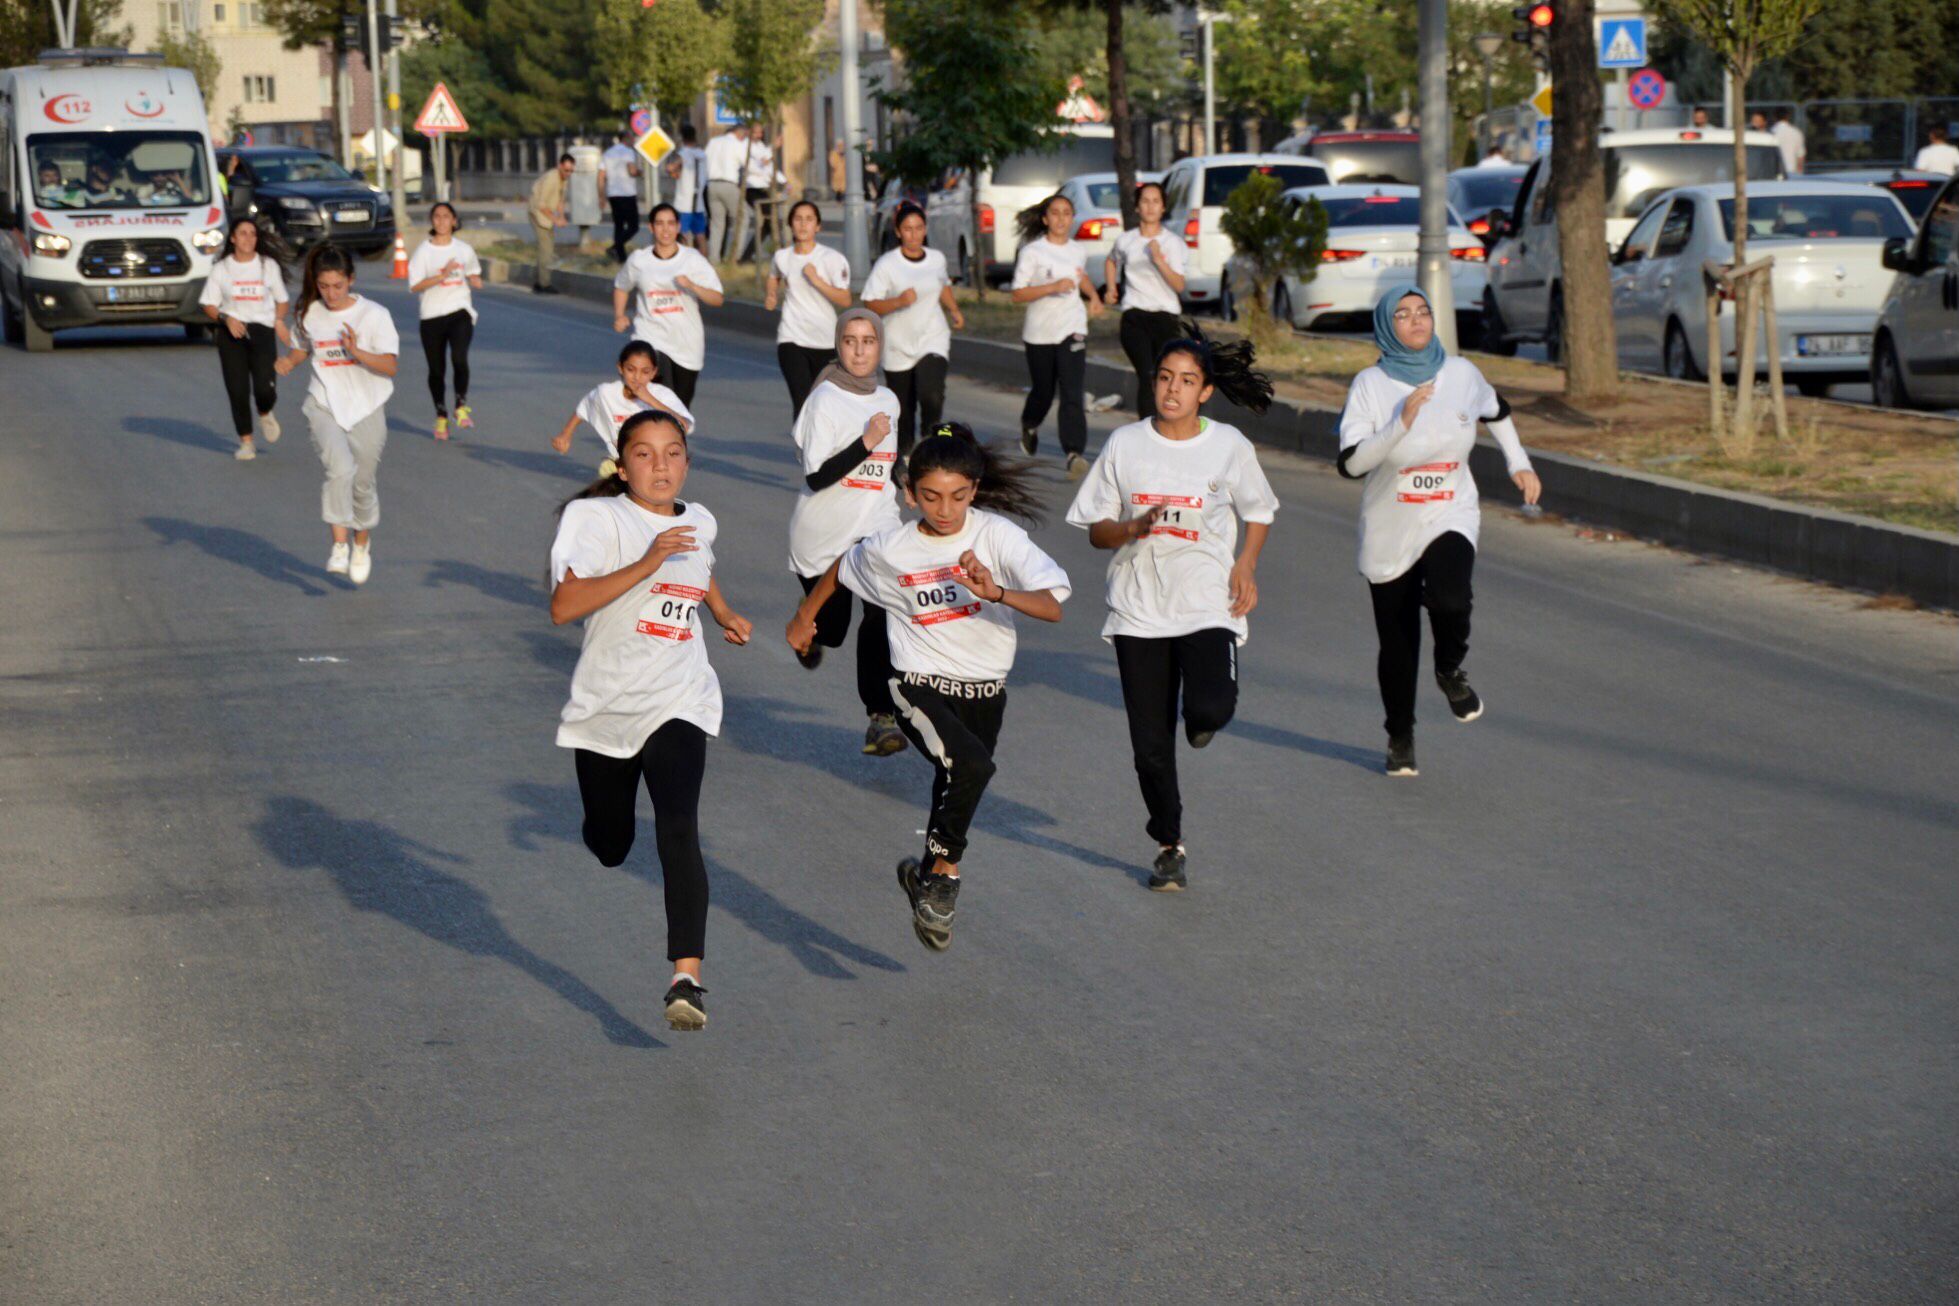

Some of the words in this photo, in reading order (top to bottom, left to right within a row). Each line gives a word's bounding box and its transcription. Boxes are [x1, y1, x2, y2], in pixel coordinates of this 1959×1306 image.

[64, 101, 91, 113] 112
[1161, 509, 1181, 523] 11
[917, 585, 957, 607] 005
[904, 671, 962, 698] NEVER
